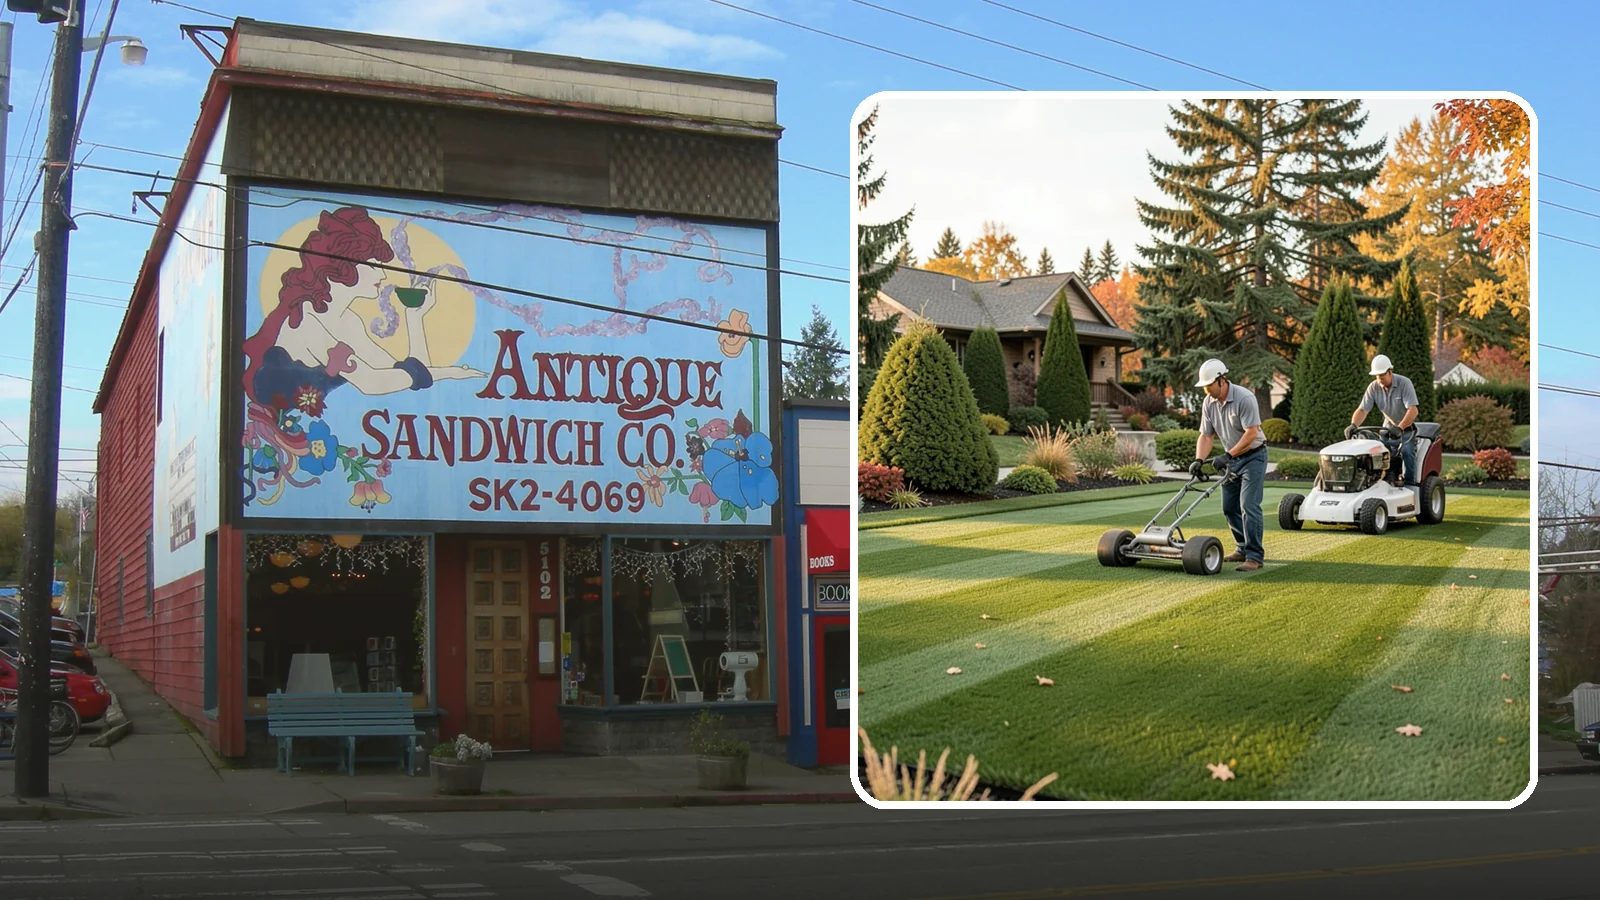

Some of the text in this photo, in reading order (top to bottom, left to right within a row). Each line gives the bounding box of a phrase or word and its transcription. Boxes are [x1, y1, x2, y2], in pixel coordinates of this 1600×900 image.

[475, 329, 723, 421] ANTIQUE
[361, 408, 685, 468] SANDWICH CO.
[468, 476, 646, 513] SK2-4069
[540, 541, 551, 600] 5102
[809, 555, 835, 569] BOOKS
